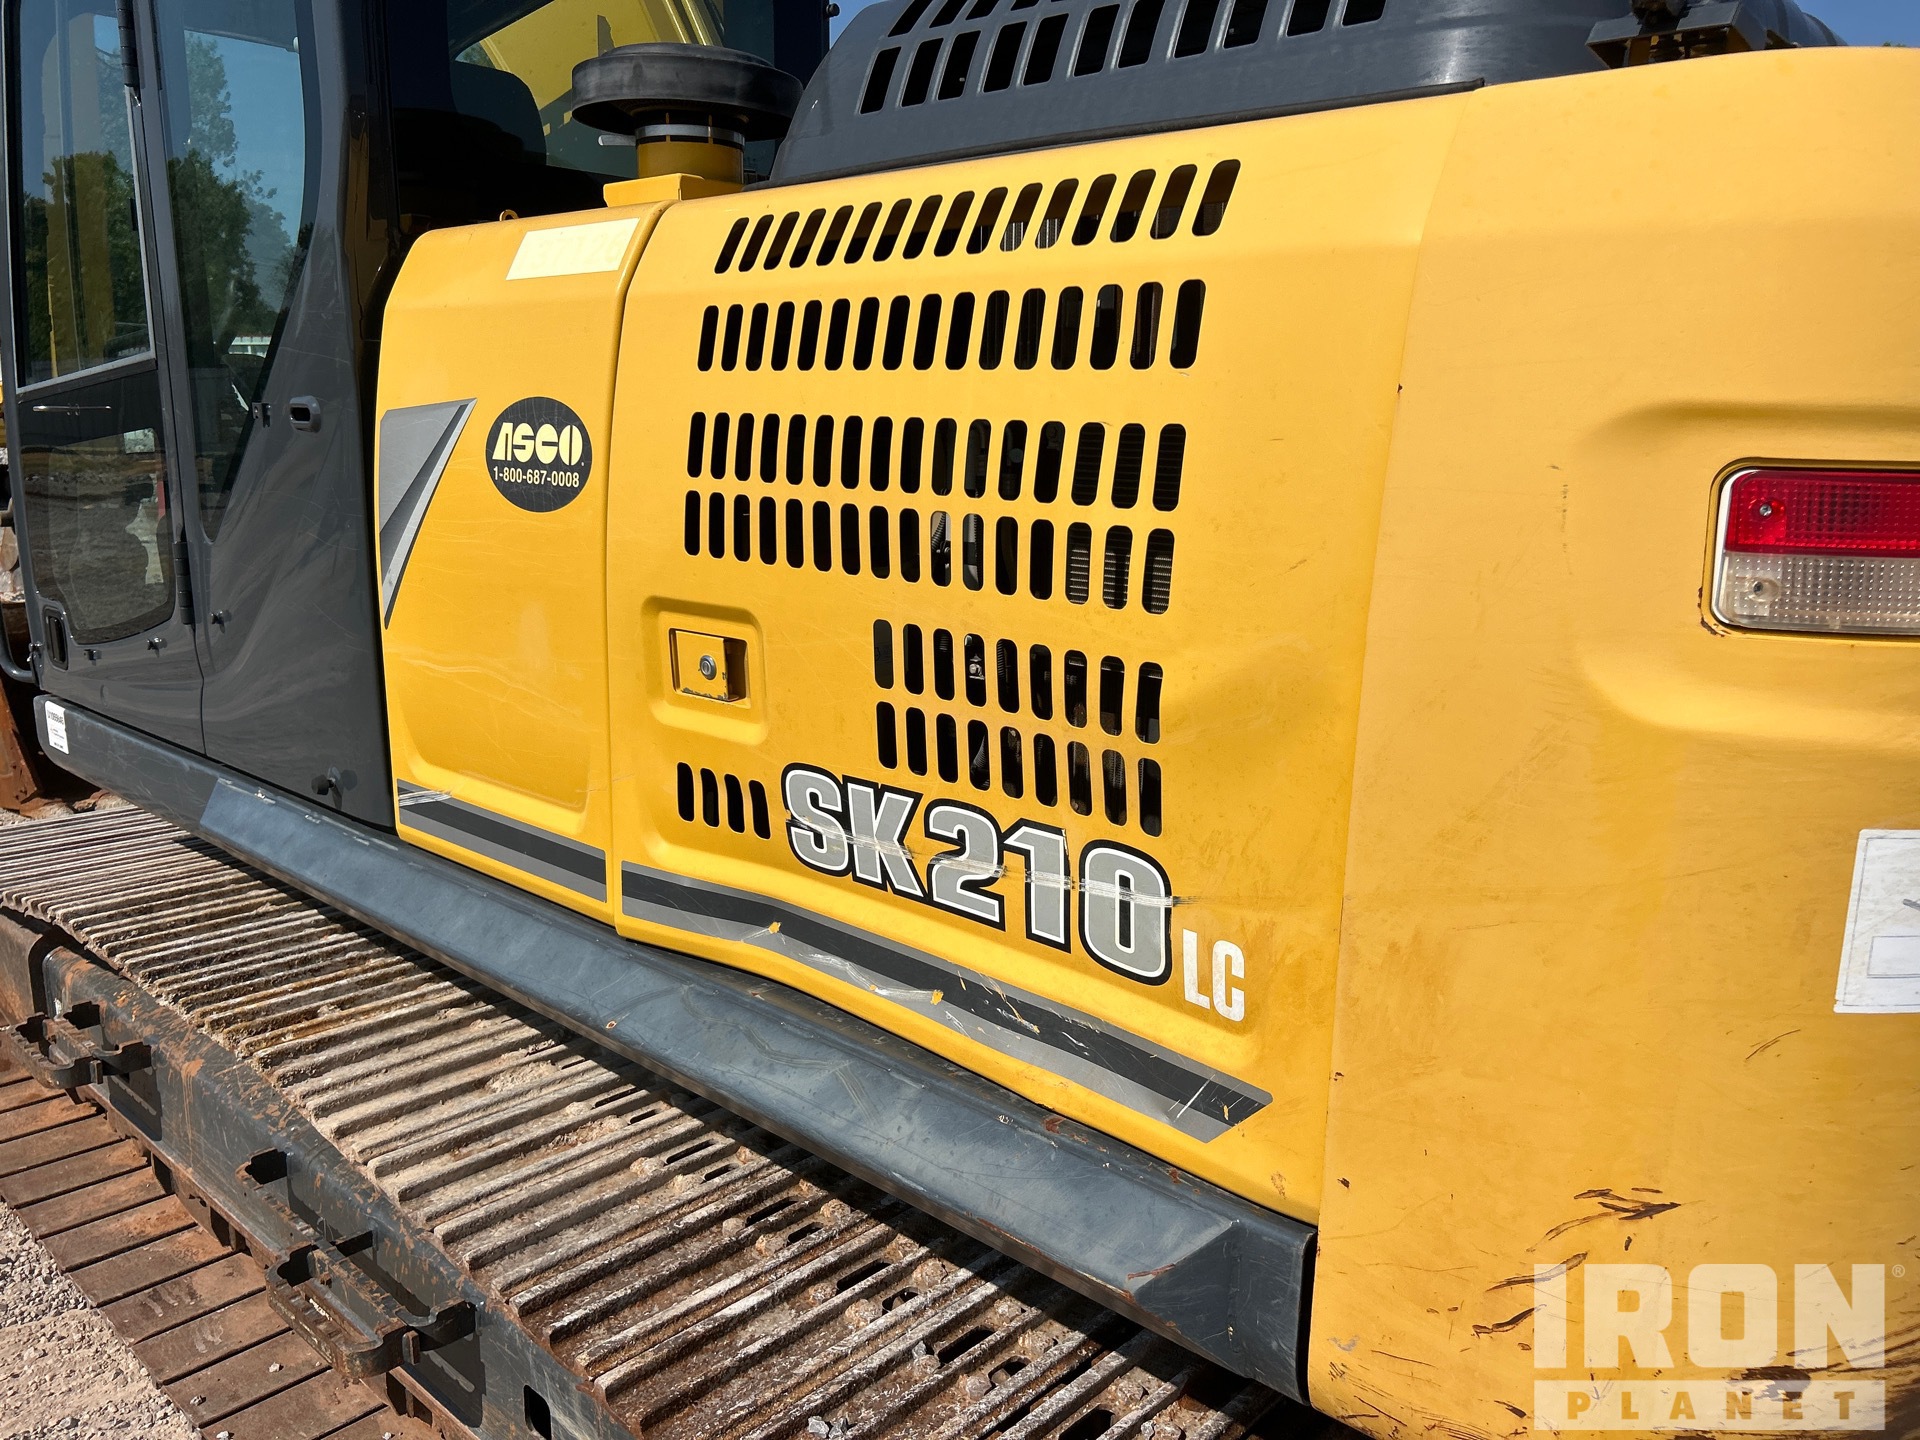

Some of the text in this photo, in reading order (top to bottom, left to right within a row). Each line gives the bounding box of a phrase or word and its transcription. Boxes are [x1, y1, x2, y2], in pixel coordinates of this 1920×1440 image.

[492, 422, 583, 466] ASCO
[493, 466, 580, 488] 1-800-687-0008
[781, 763, 1246, 1022] SK210 LC
